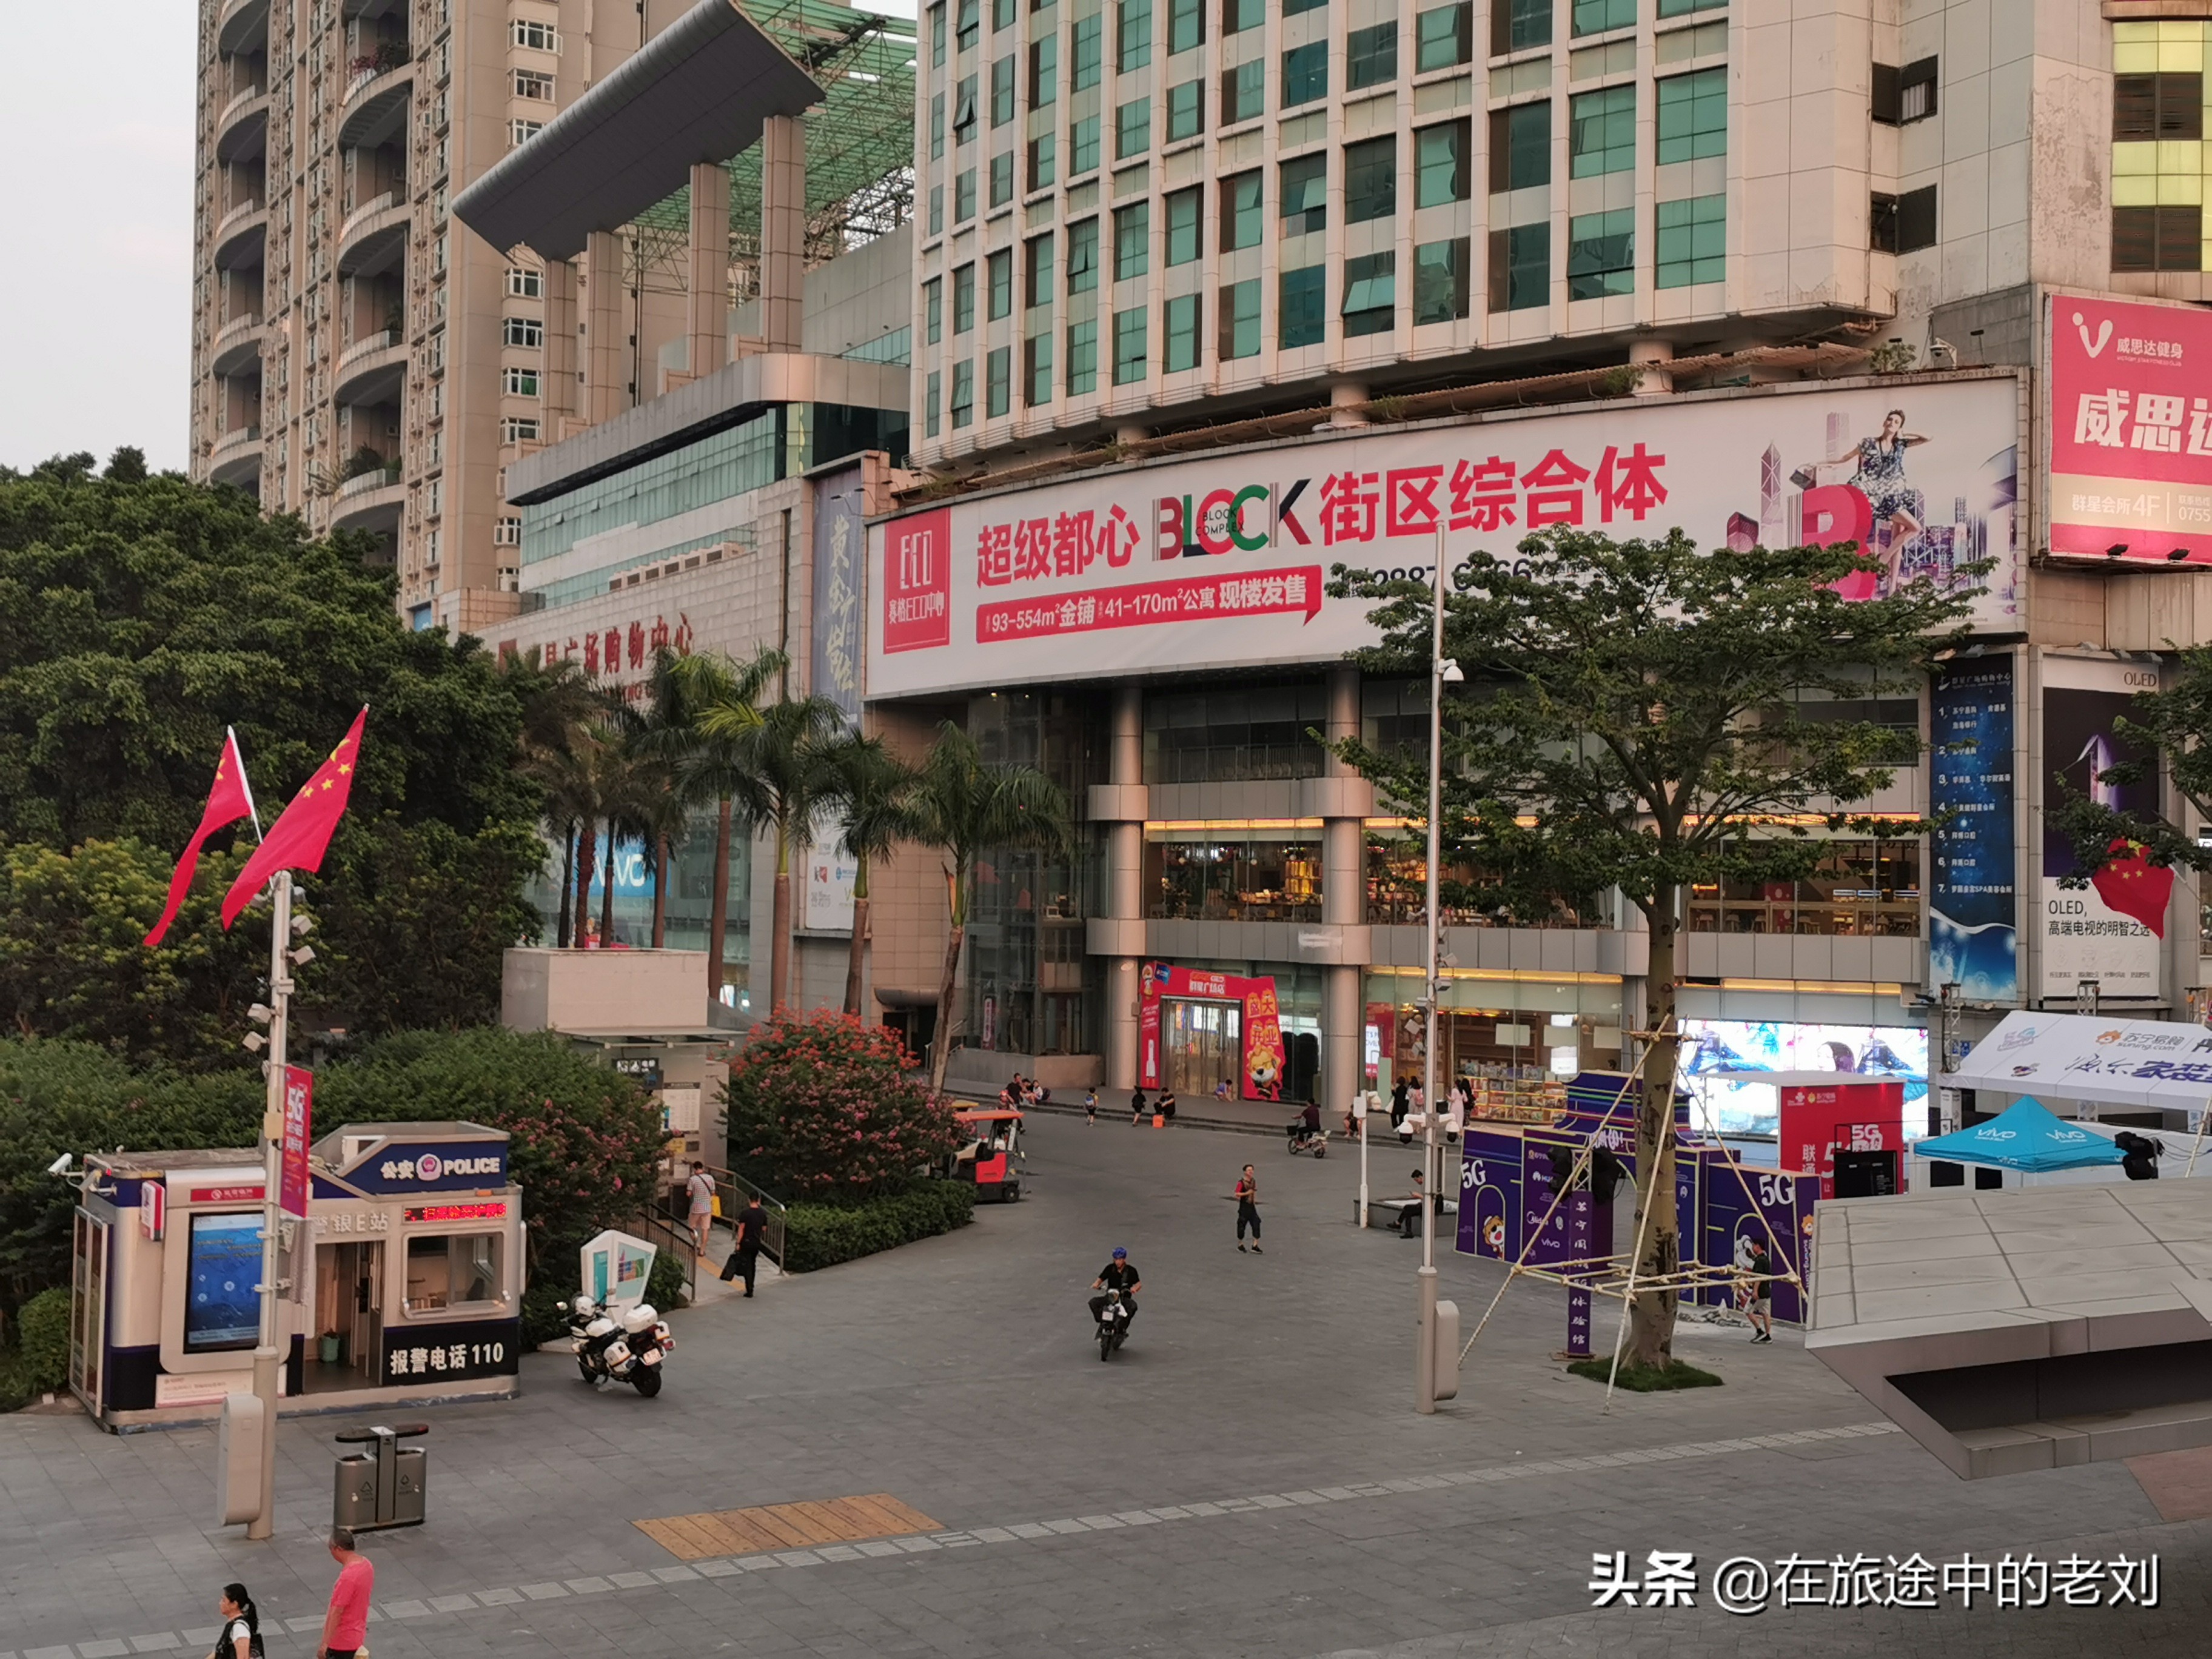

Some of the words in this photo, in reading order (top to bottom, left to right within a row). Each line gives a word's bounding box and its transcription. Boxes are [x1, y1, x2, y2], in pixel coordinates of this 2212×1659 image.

[2117, 337, 2183, 359] 威思达健身
[1319, 443, 1668, 546] 街区综合体
[2072, 494, 2160, 517] 群星会所4F
[1152, 478, 1312, 561] BLOCK
[1202, 508, 1238, 521] BLOCK
[2178, 506, 2212, 523] 0755
[1195, 522, 1245, 537] COMPLEX
[977, 503, 1141, 588] 超级都心
[1219, 574, 1307, 609] 现楼发售
[2124, 672, 2157, 686] OLED
[2048, 900, 2088, 917] OLED,
[2116, 1042, 2176, 1051] suning.com
[2123, 1033, 2185, 1046] 苏宁易购
[380, 1160, 415, 1179] 公安
[444, 1157, 501, 1175] POLICE
[1460, 1159, 1487, 1189] 5G
[1759, 1173, 1795, 1207] 5G
[1541, 1239, 1561, 1249] vivo
[390, 1344, 467, 1376] 报警电话
[472, 1342, 504, 1365] 110
